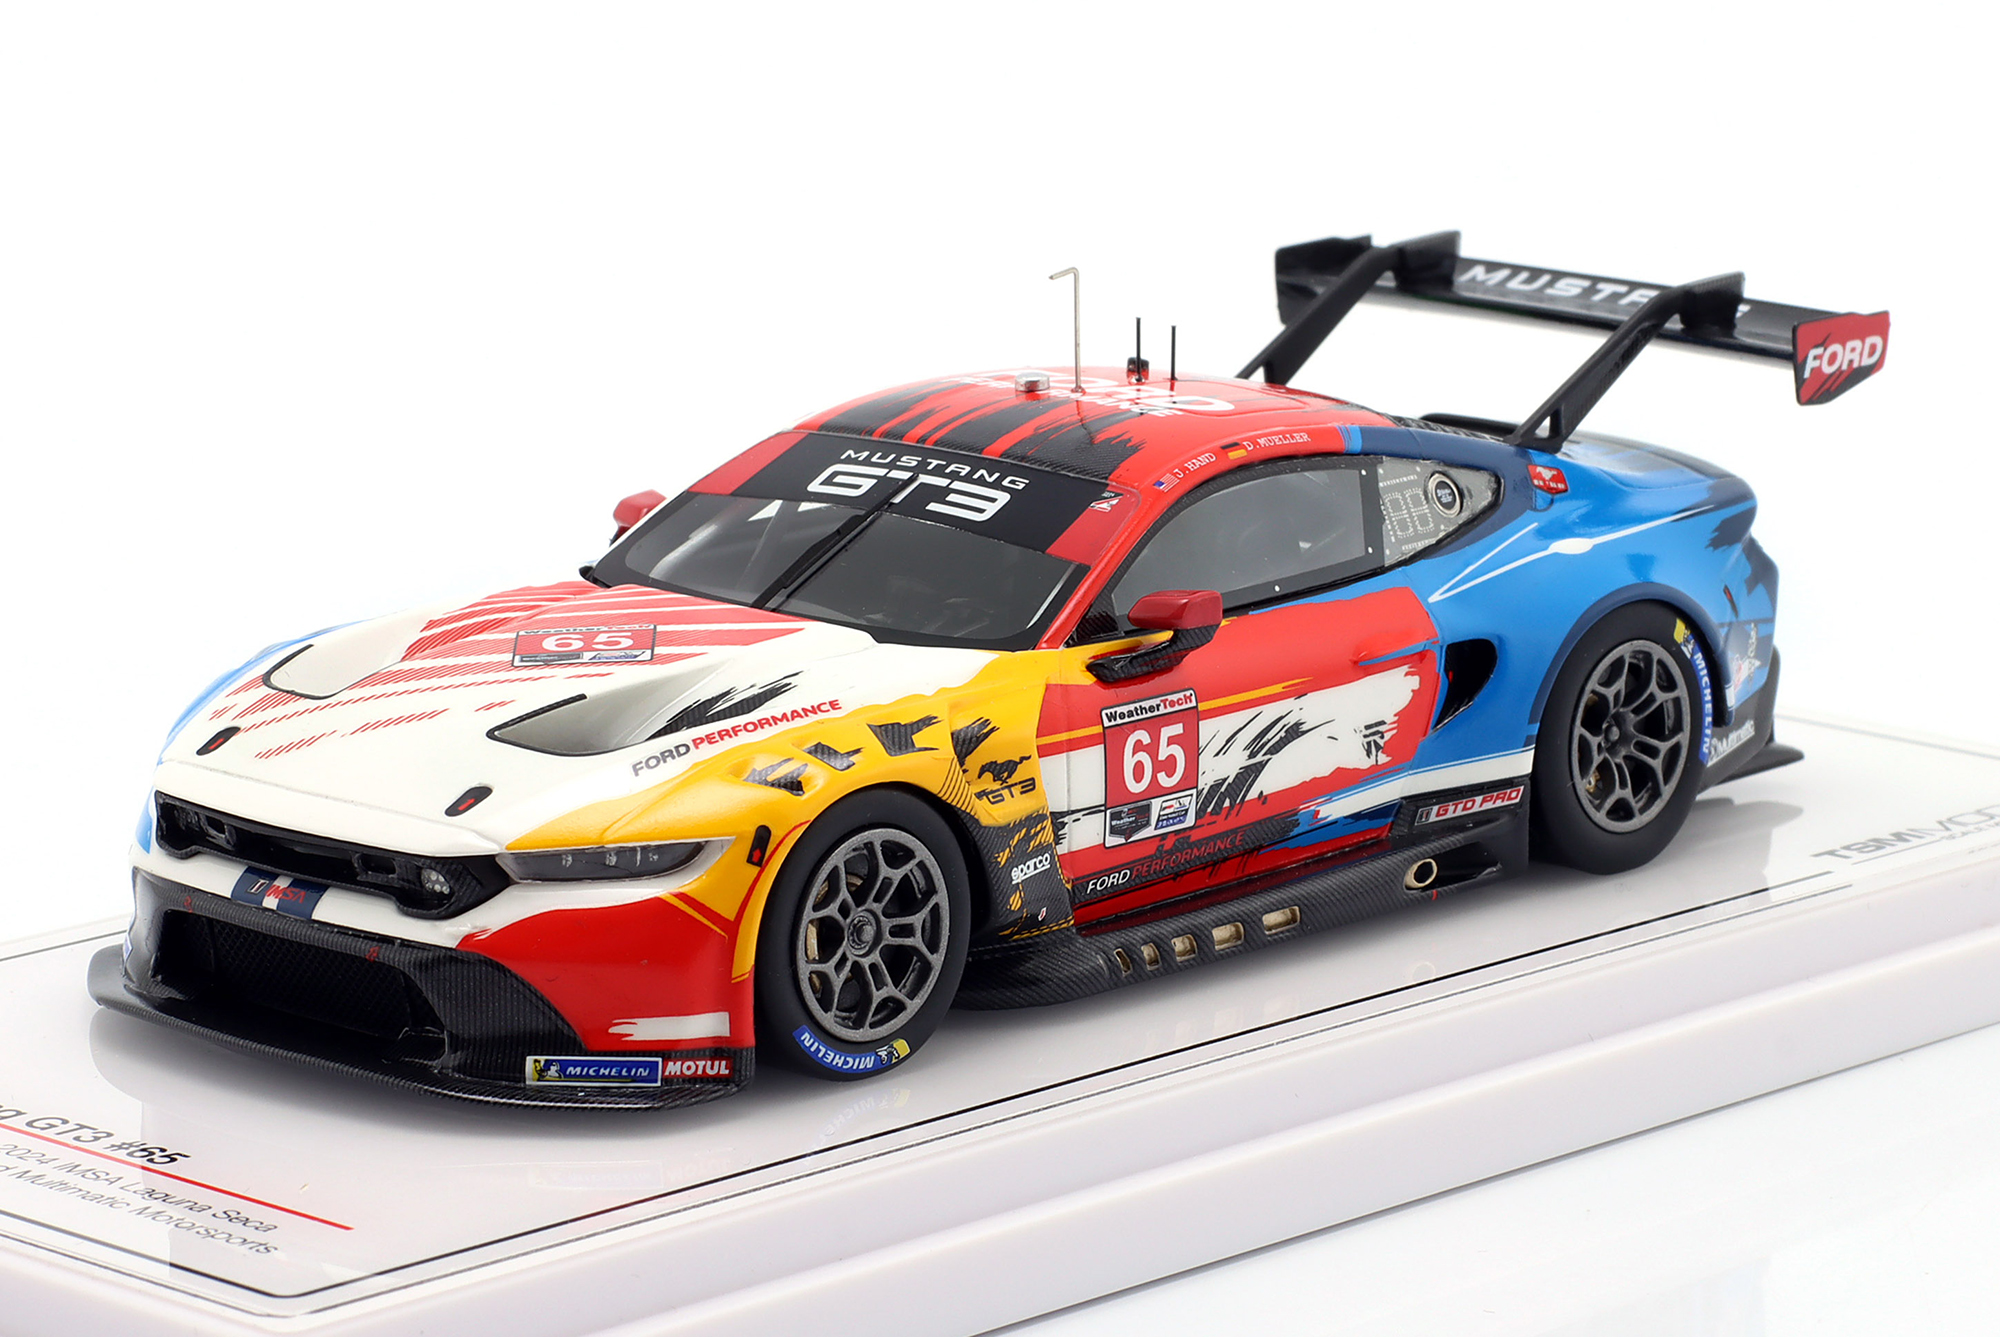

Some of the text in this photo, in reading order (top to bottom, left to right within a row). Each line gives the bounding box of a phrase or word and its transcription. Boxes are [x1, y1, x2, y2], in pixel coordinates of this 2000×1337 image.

[1802, 334, 1885, 379] FORD
[839, 449, 1030, 491] MUSTANG
[806, 463, 1012, 522] GT3
[541, 632, 634, 652] 65
[1104, 693, 1194, 724] WeatherTech
[1693, 652, 1713, 753] MICHELIN
[631, 699, 843, 777] FORD PERFORMANCE
[1123, 722, 1186, 794] 65
[982, 776, 1037, 806] GT3
[1435, 787, 1522, 818] GTD PRO
[1011, 851, 1051, 881] sparco
[1086, 831, 1247, 894] FORD PERFORMANCE
[265, 884, 307, 904] IMSA
[565, 1065, 651, 1078] MICHELIN
[664, 1058, 730, 1078] MOTUL
[800, 1031, 875, 1070] MICHELIN
[25, 1116, 192, 1165] GT3 #65
[7, 1169, 279, 1255] Multimatic Motorsports
[52, 1161, 124, 1186] IMSA
[118, 1181, 213, 1214] Laguna
[211, 1208, 279, 1233] Seca
